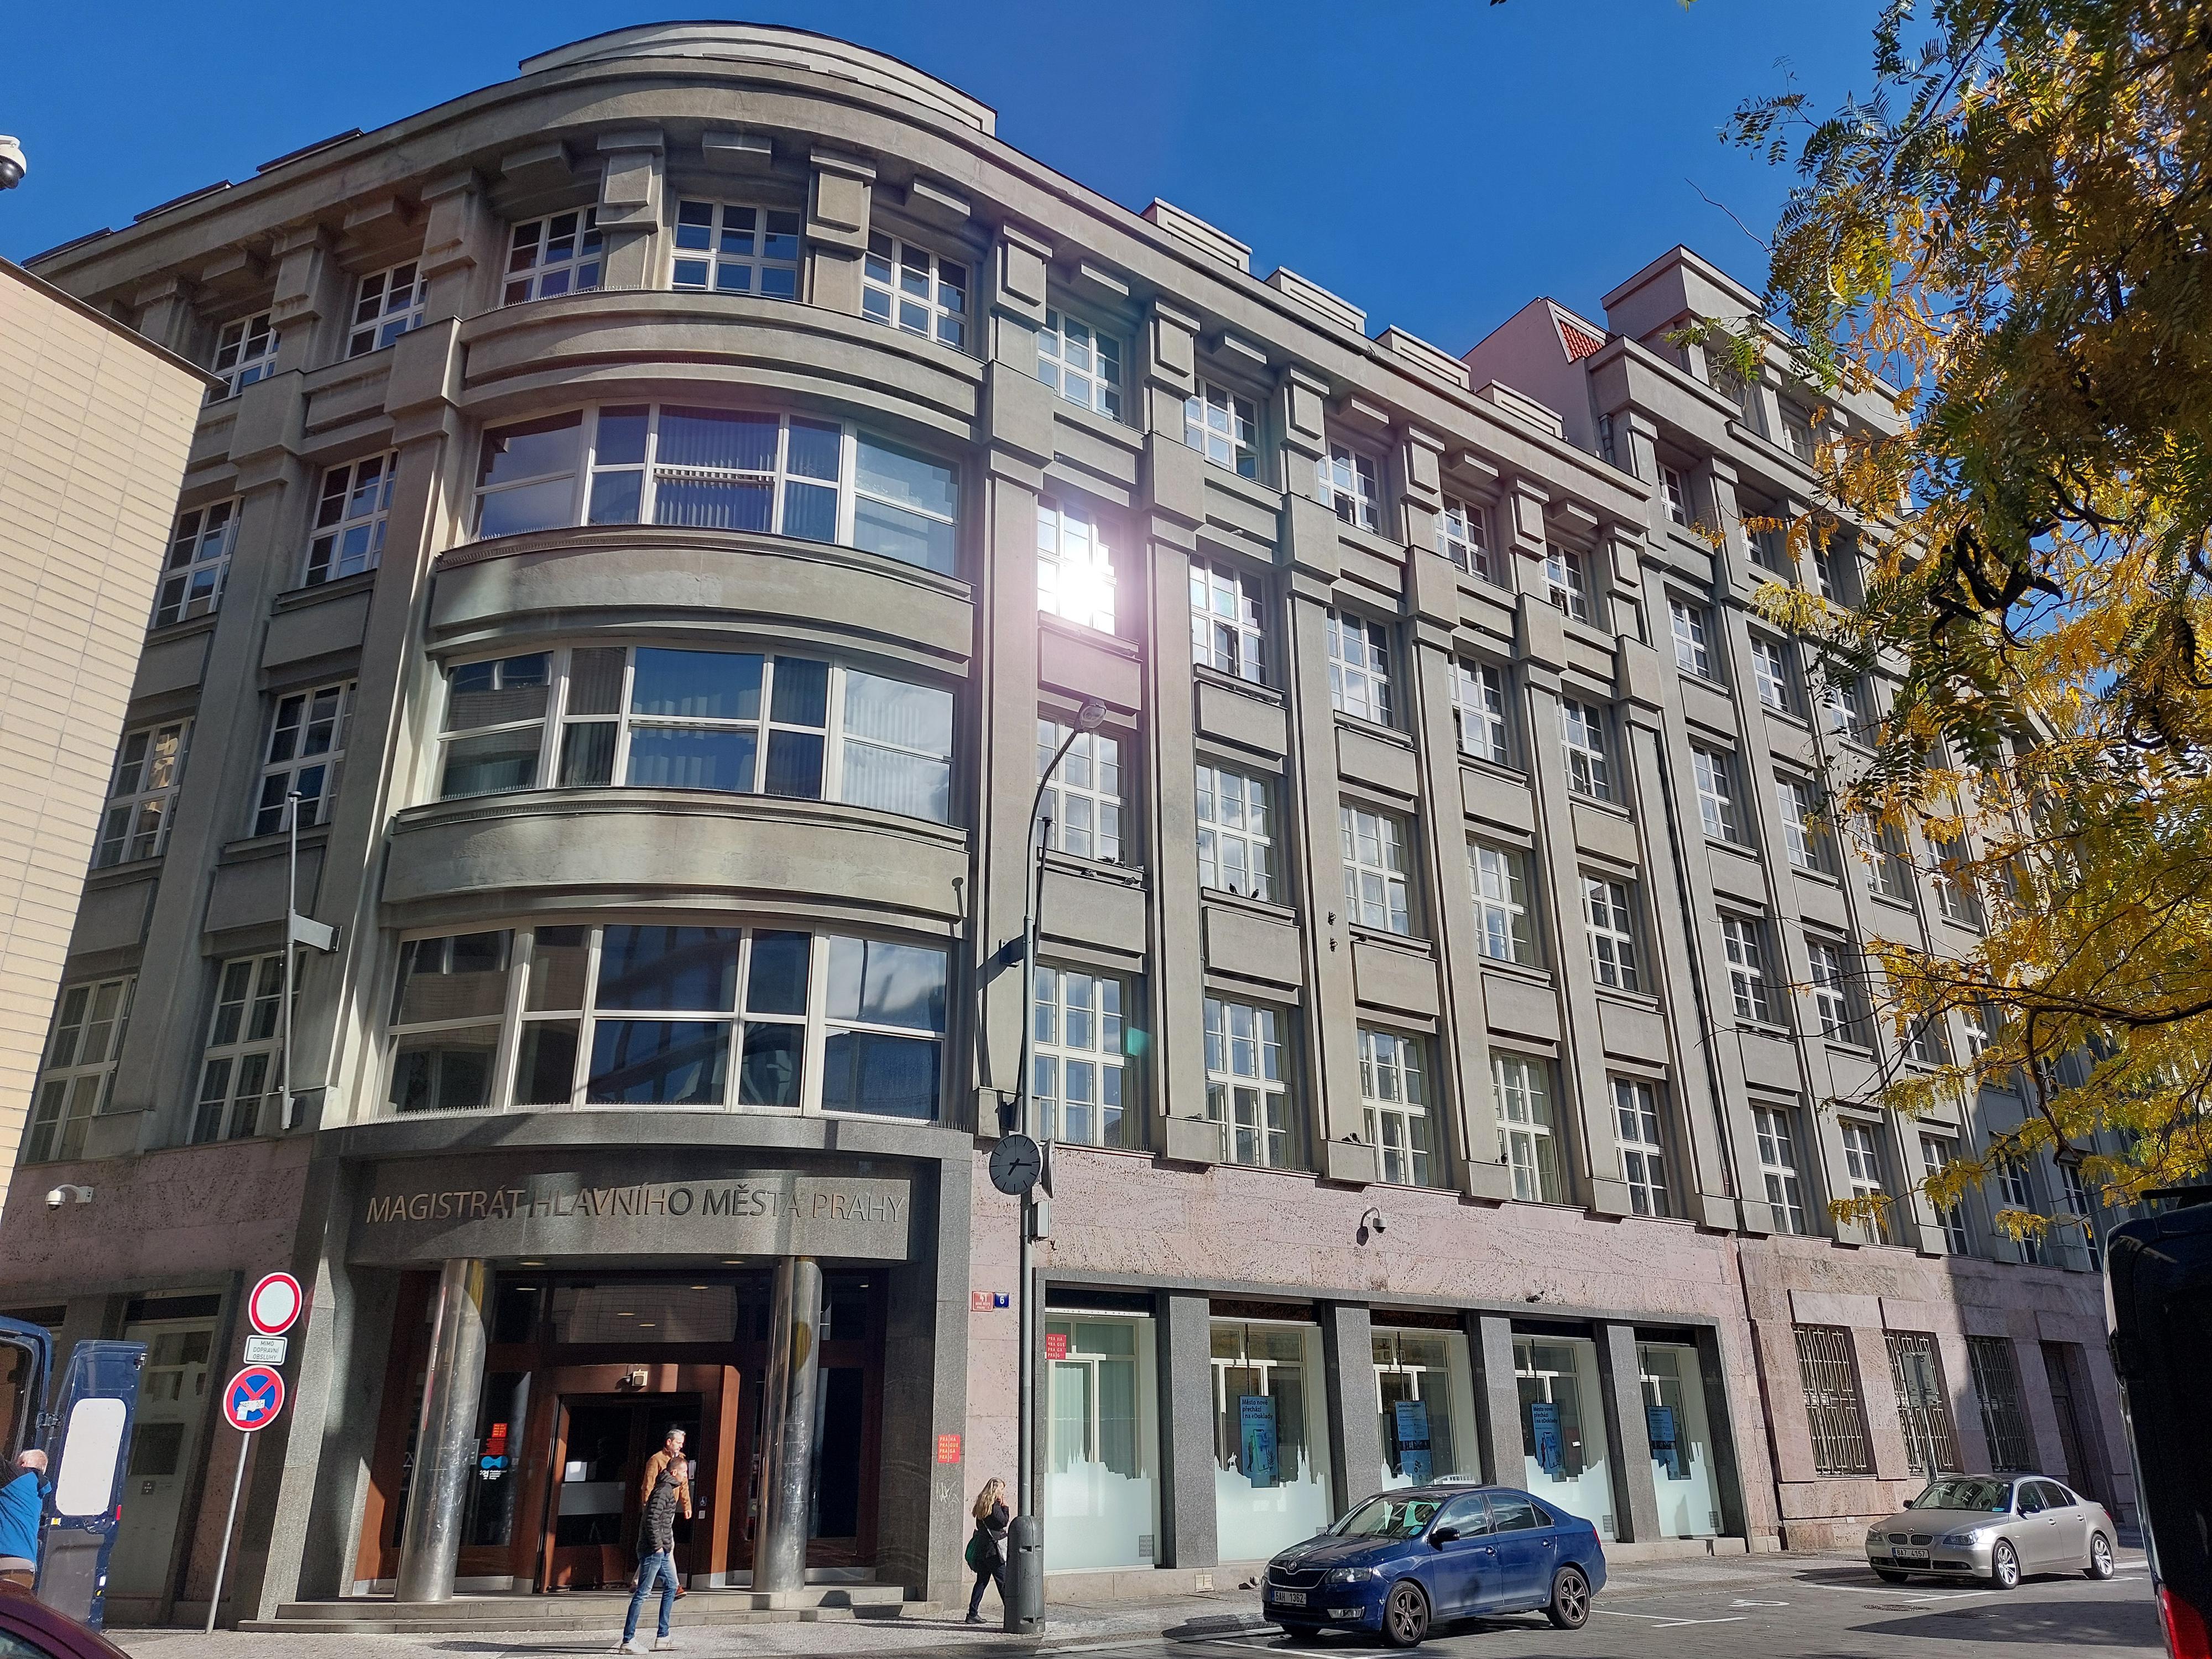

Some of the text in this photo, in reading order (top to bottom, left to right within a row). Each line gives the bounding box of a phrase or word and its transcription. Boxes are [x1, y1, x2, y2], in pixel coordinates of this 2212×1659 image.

[366, 1182, 905, 1223] MAGISTRÁT HLAVNÍHO MĚSTA PRAHY
[999, 1296, 1005, 1305] 6
[1275, 1592, 1304, 1603] 5AH 1362
